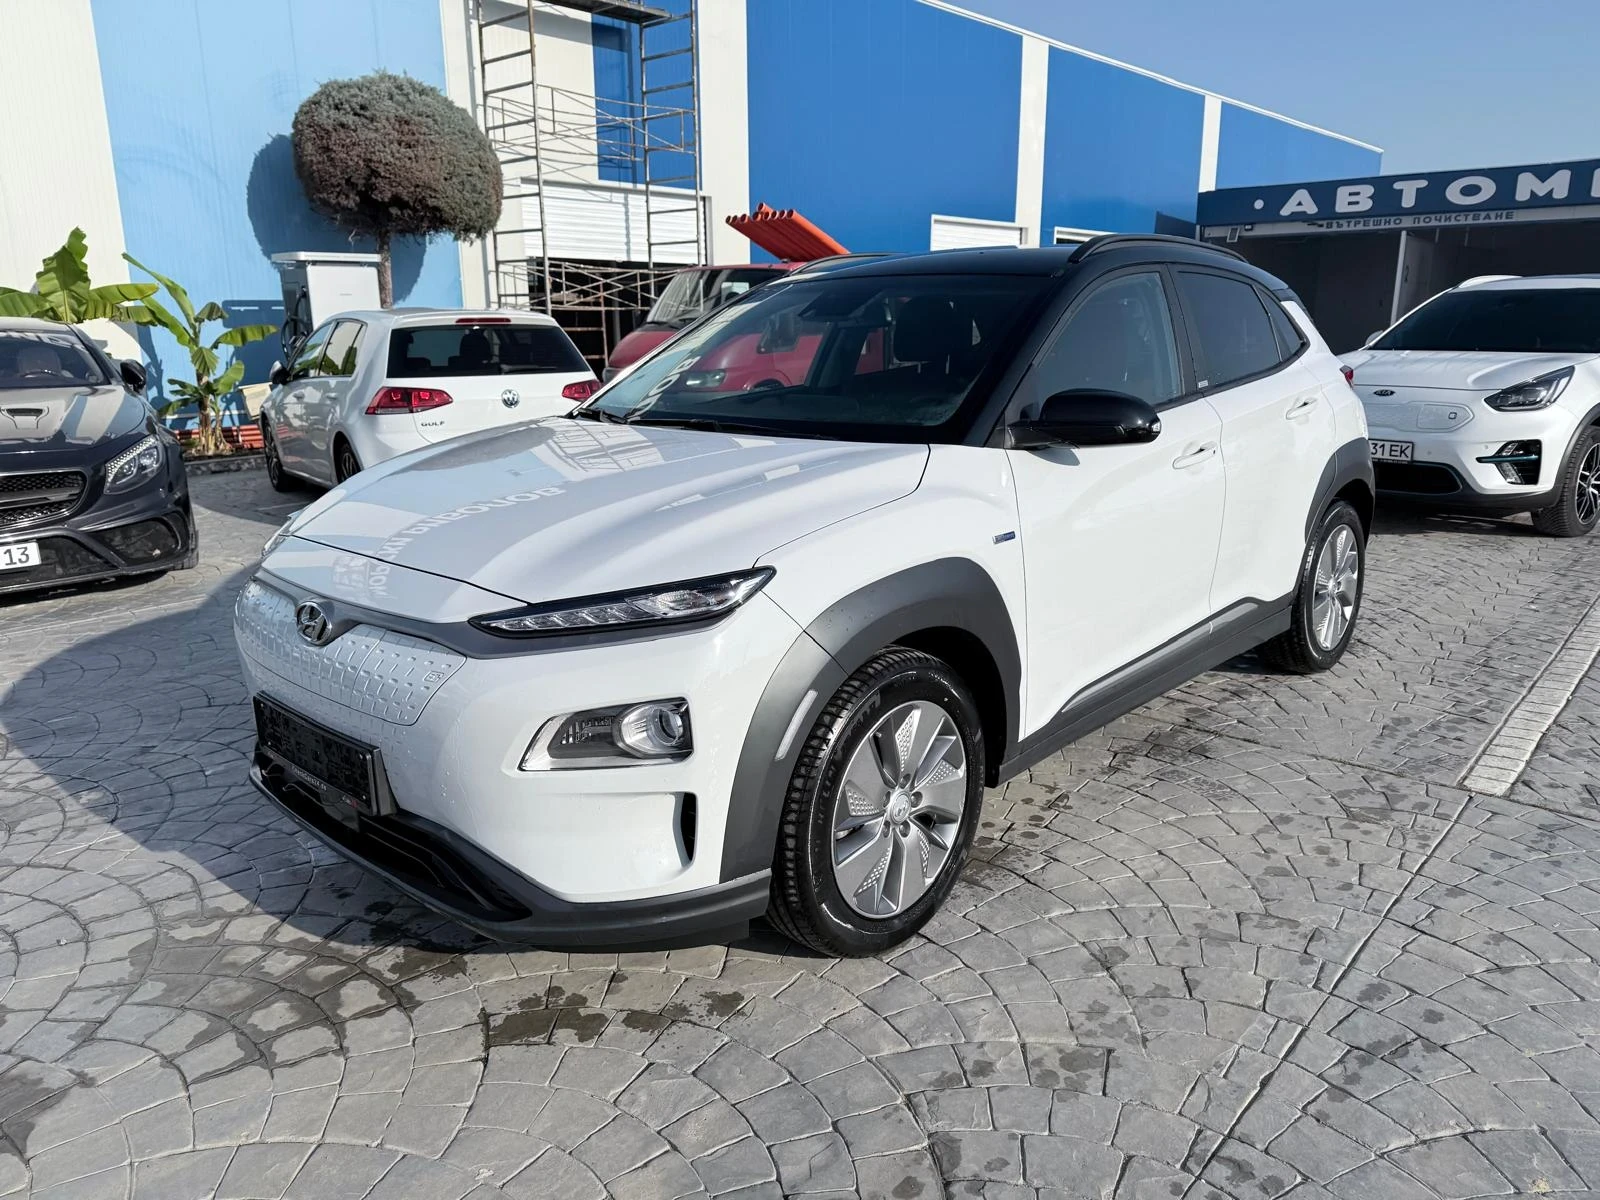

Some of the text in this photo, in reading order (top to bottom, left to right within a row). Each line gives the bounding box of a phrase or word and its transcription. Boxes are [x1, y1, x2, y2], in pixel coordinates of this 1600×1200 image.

[1326, 211, 1514, 229] ВЪТРЕШНО ПОЧИСТВАНЕ
[420, 420, 446, 428] GOLF
[1370, 442, 1411, 459] 31 EK
[3, 546, 30, 566] 13
